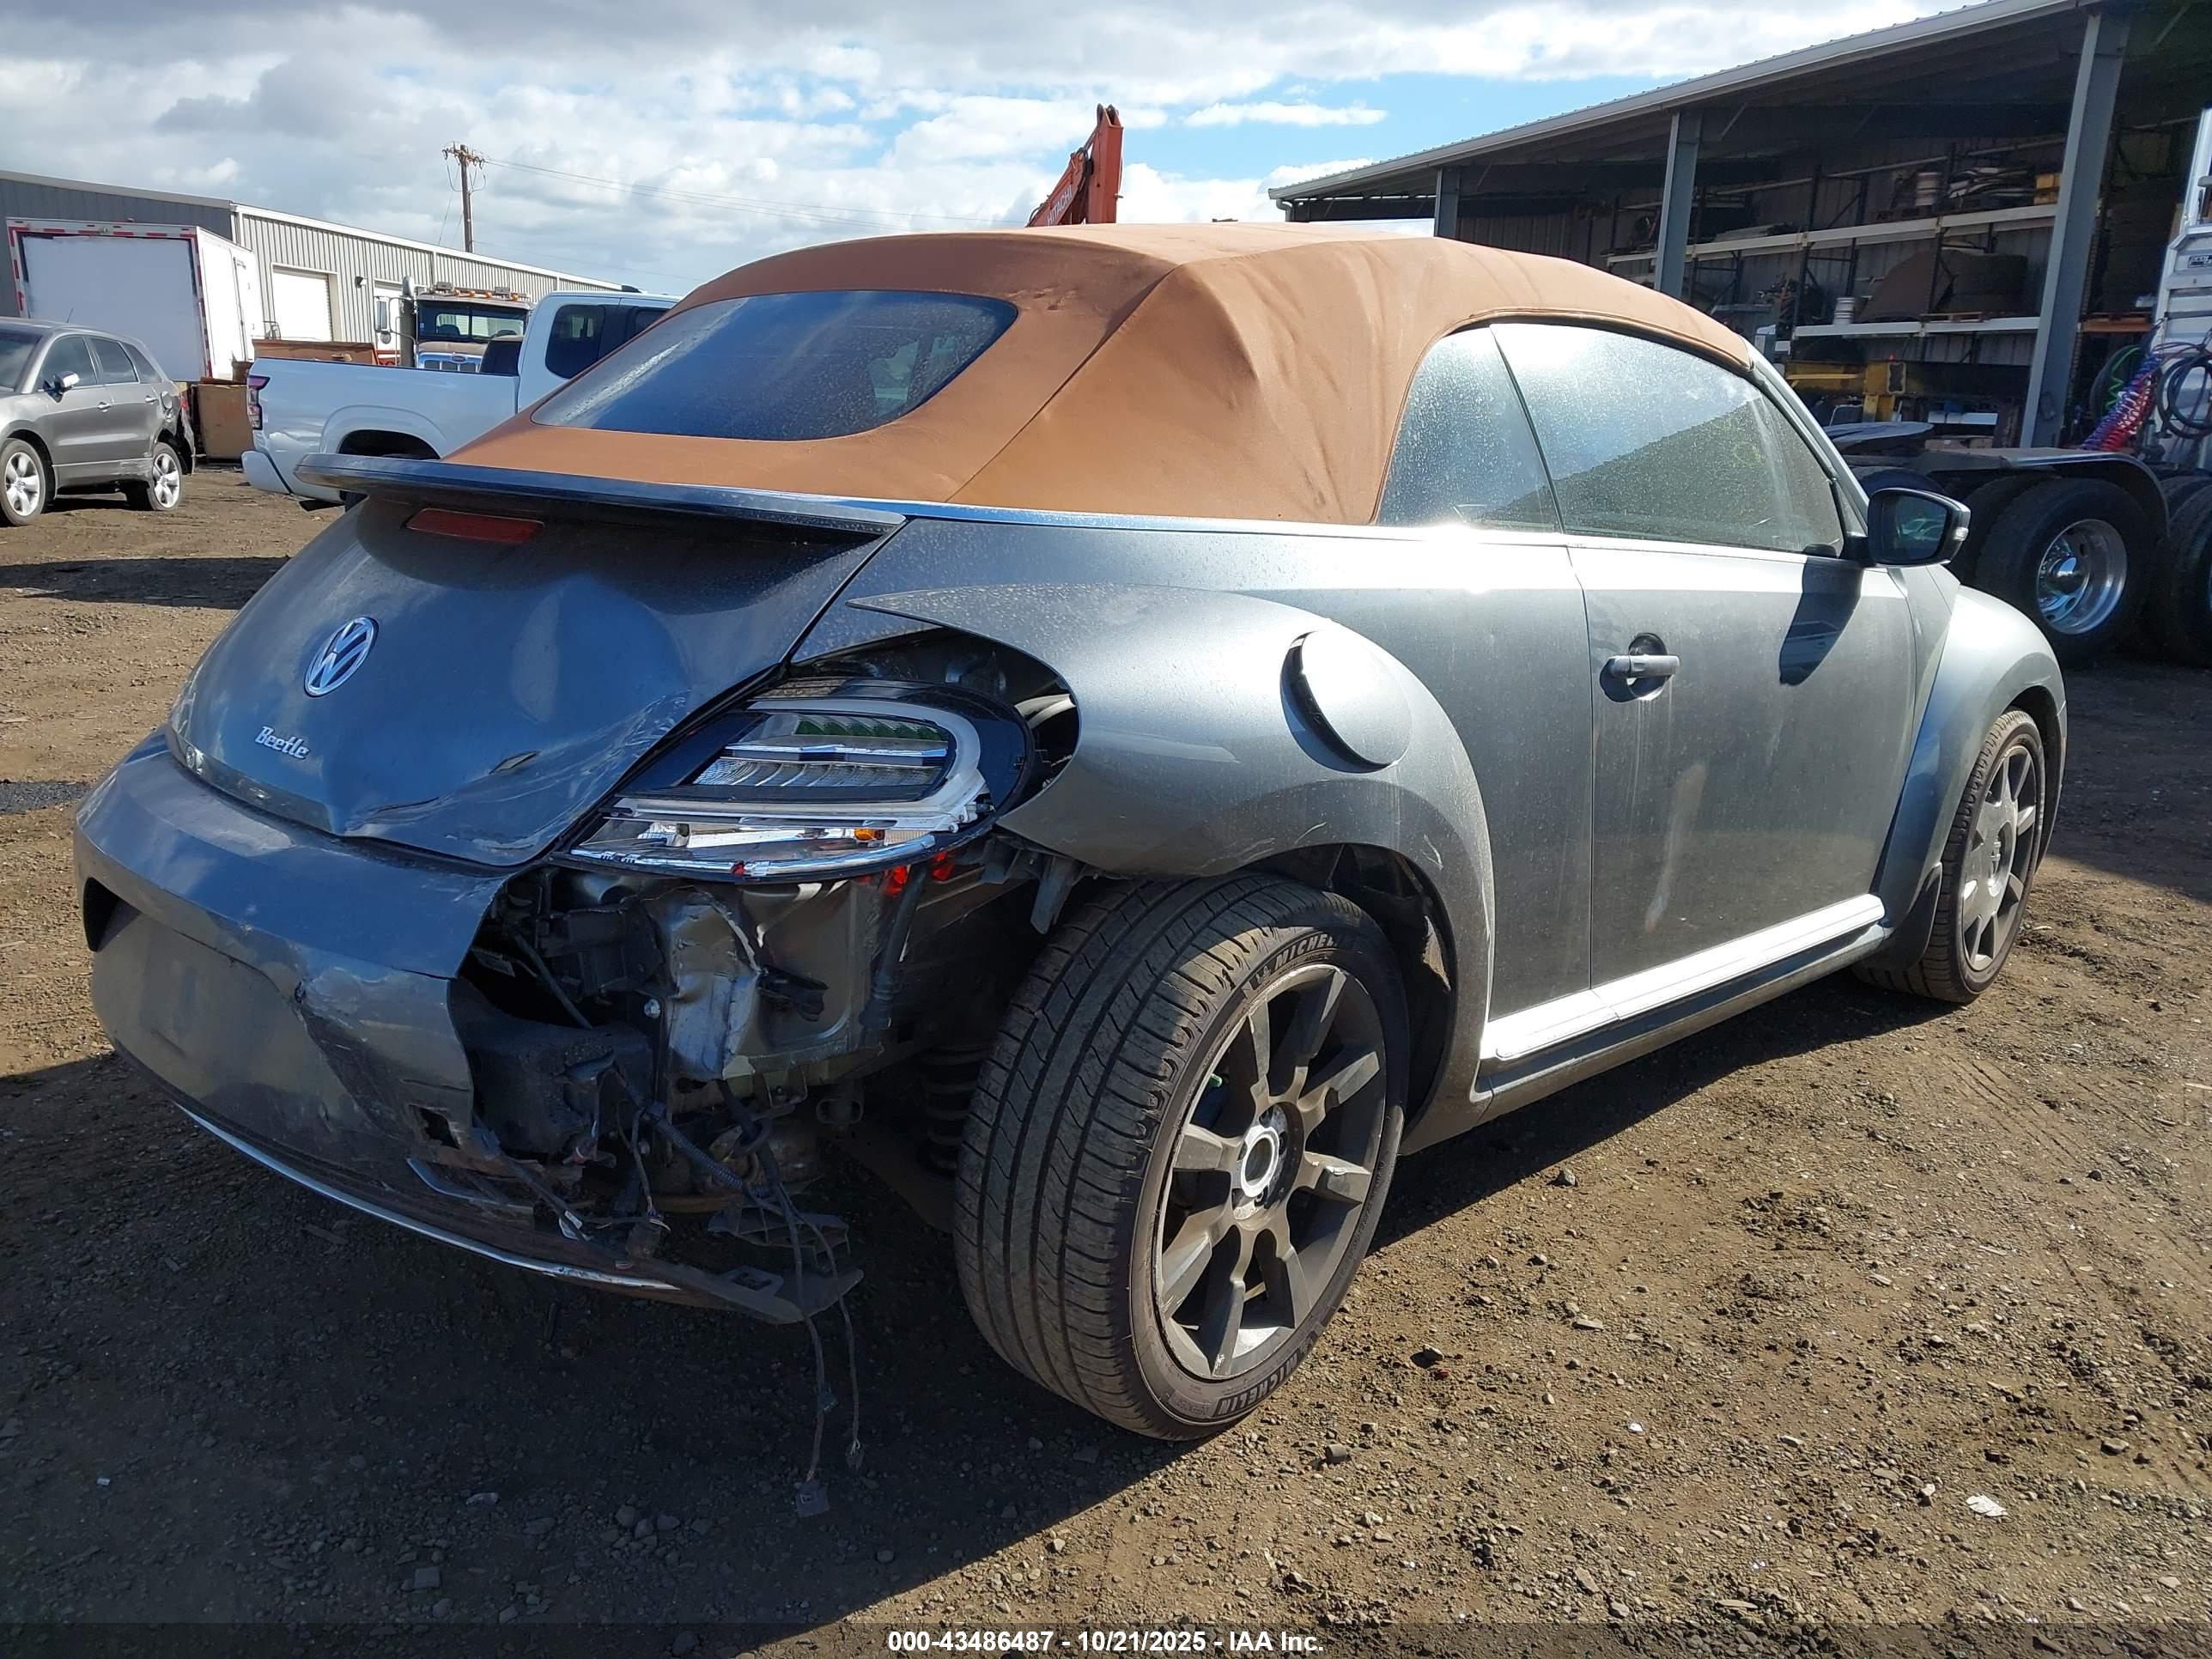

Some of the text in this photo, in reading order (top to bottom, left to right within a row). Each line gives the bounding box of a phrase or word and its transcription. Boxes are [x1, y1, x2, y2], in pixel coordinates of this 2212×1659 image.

[1047, 185, 1073, 227] HITACHI
[255, 726, 309, 759] Beetle
[1218, 1353, 1298, 1416] MICHELIN
